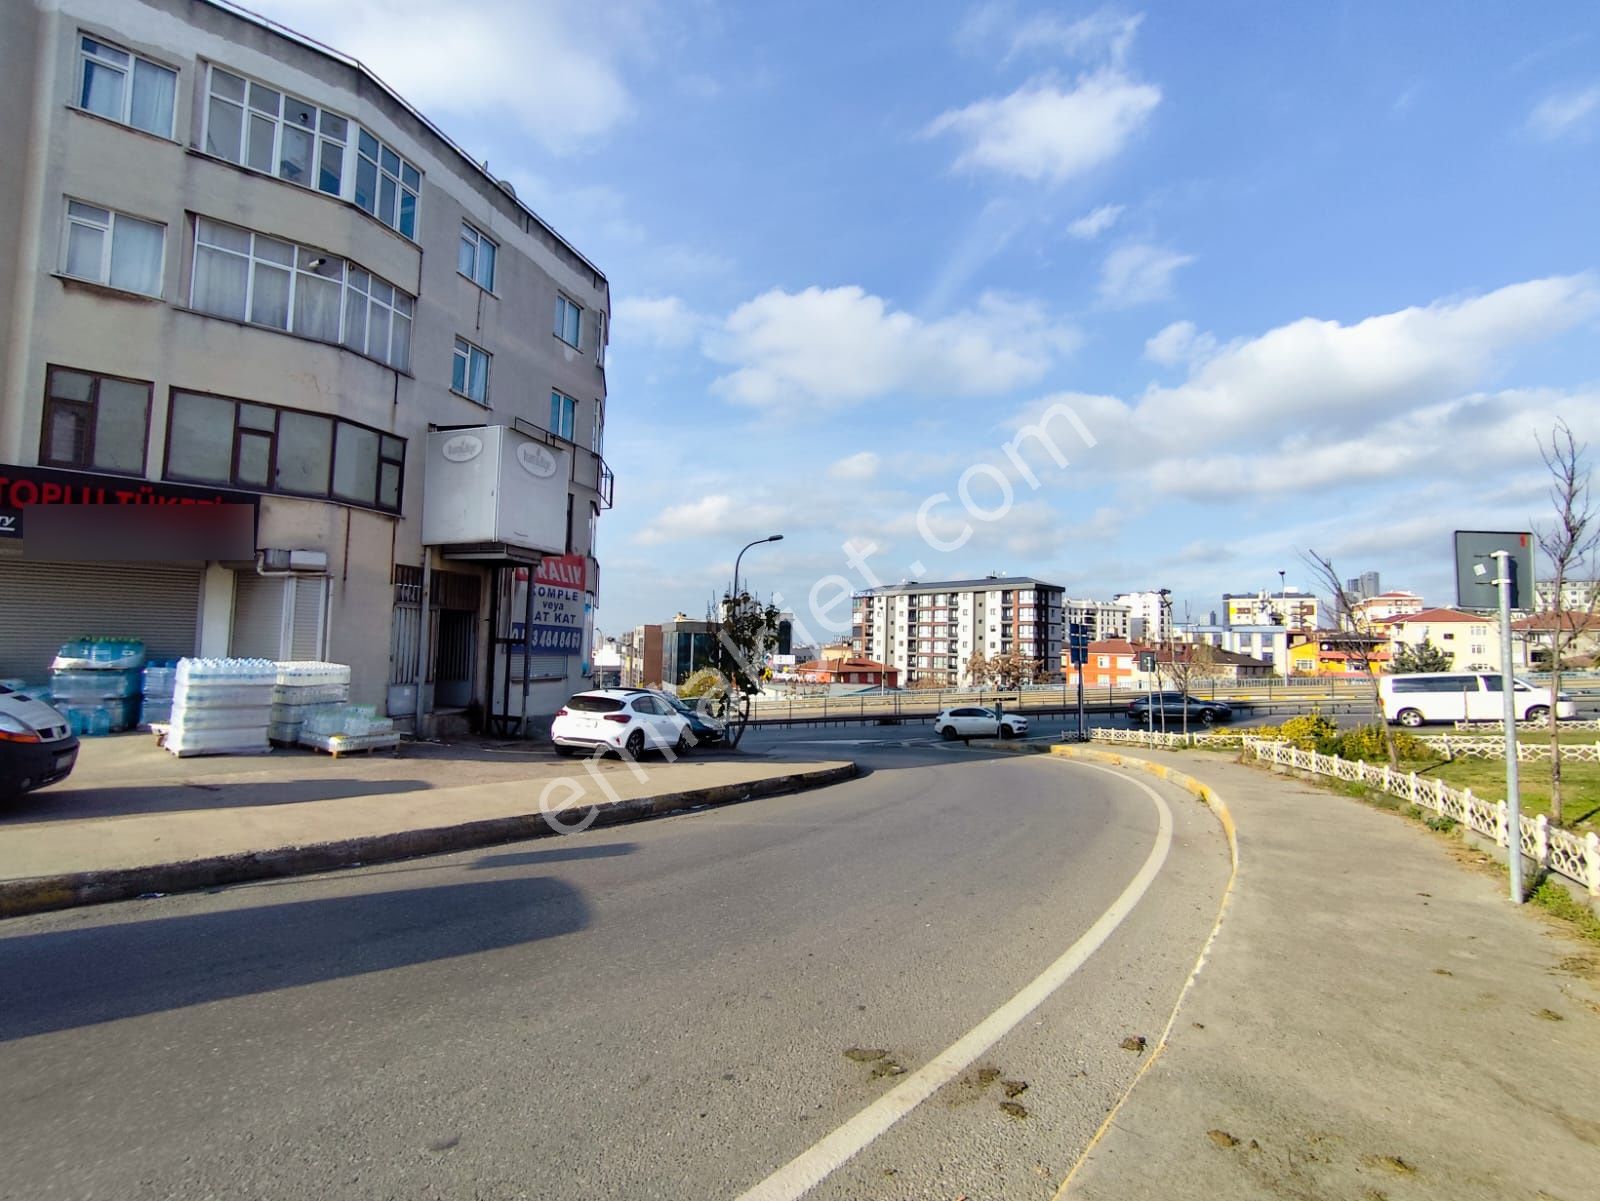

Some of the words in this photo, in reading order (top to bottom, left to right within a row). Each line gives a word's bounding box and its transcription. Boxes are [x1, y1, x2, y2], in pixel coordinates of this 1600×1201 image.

[534, 586, 578, 601] OMPLE
[543, 601, 564, 612] veya
[554, 613, 576, 624] KAT
